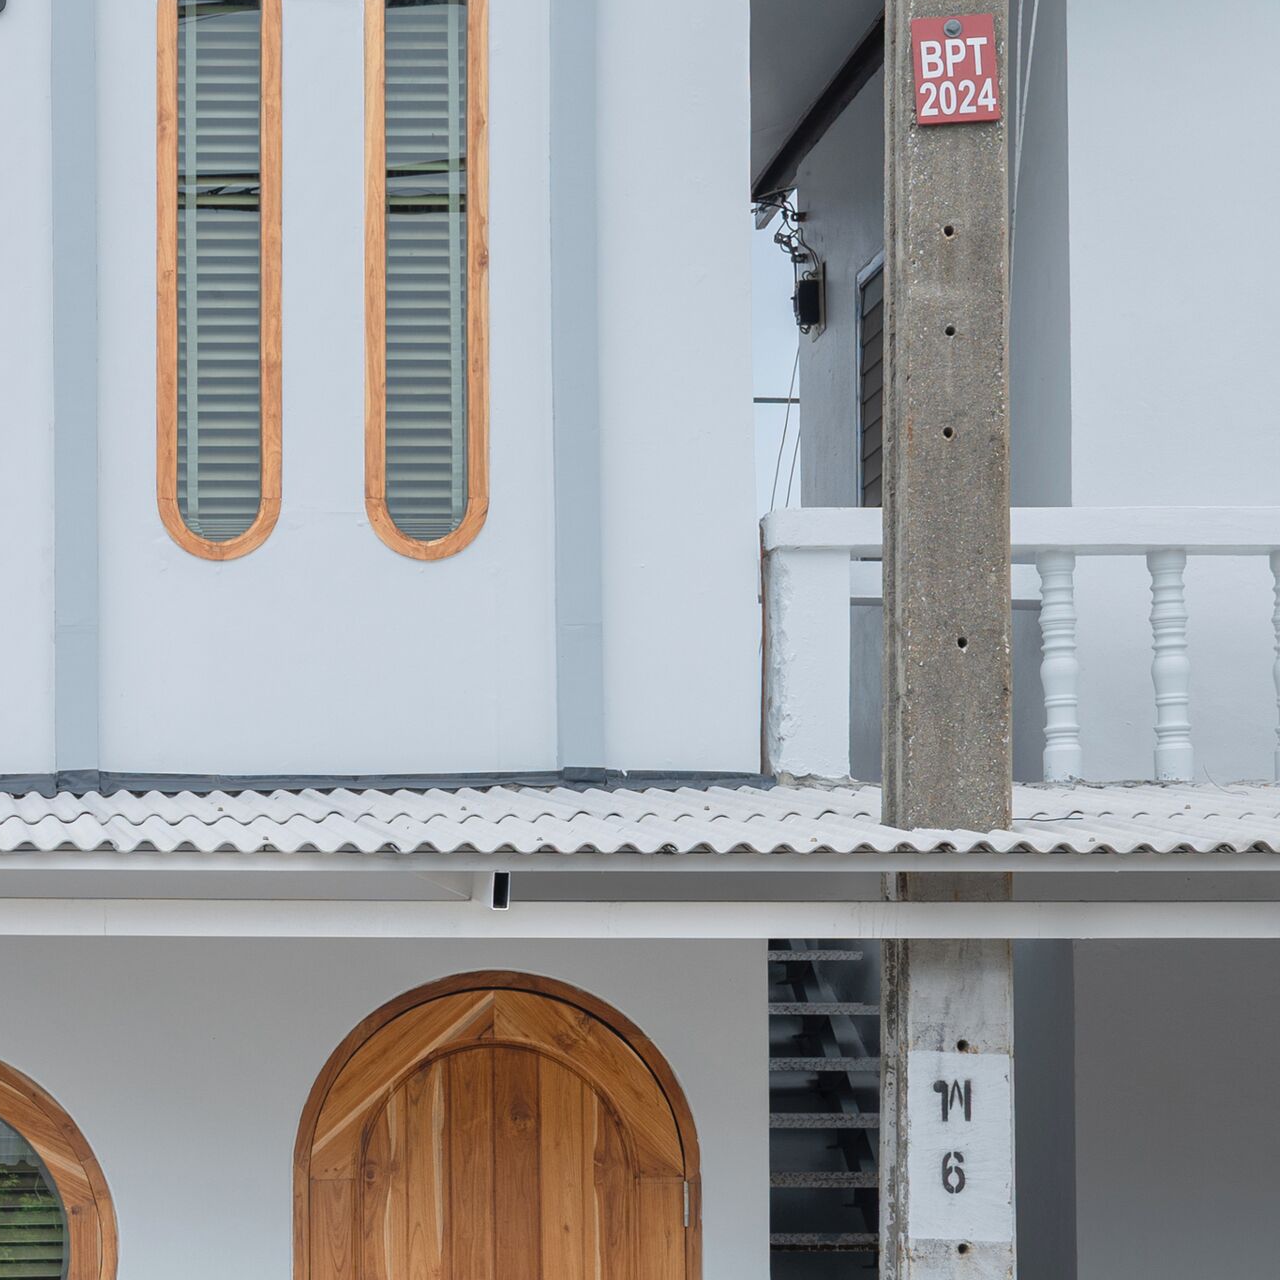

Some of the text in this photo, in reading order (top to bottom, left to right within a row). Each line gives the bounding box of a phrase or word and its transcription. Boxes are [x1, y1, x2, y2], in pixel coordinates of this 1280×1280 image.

[920, 36, 988, 79] BPT
[919, 77, 997, 117] 2024
[941, 1151, 966, 1194] 6
